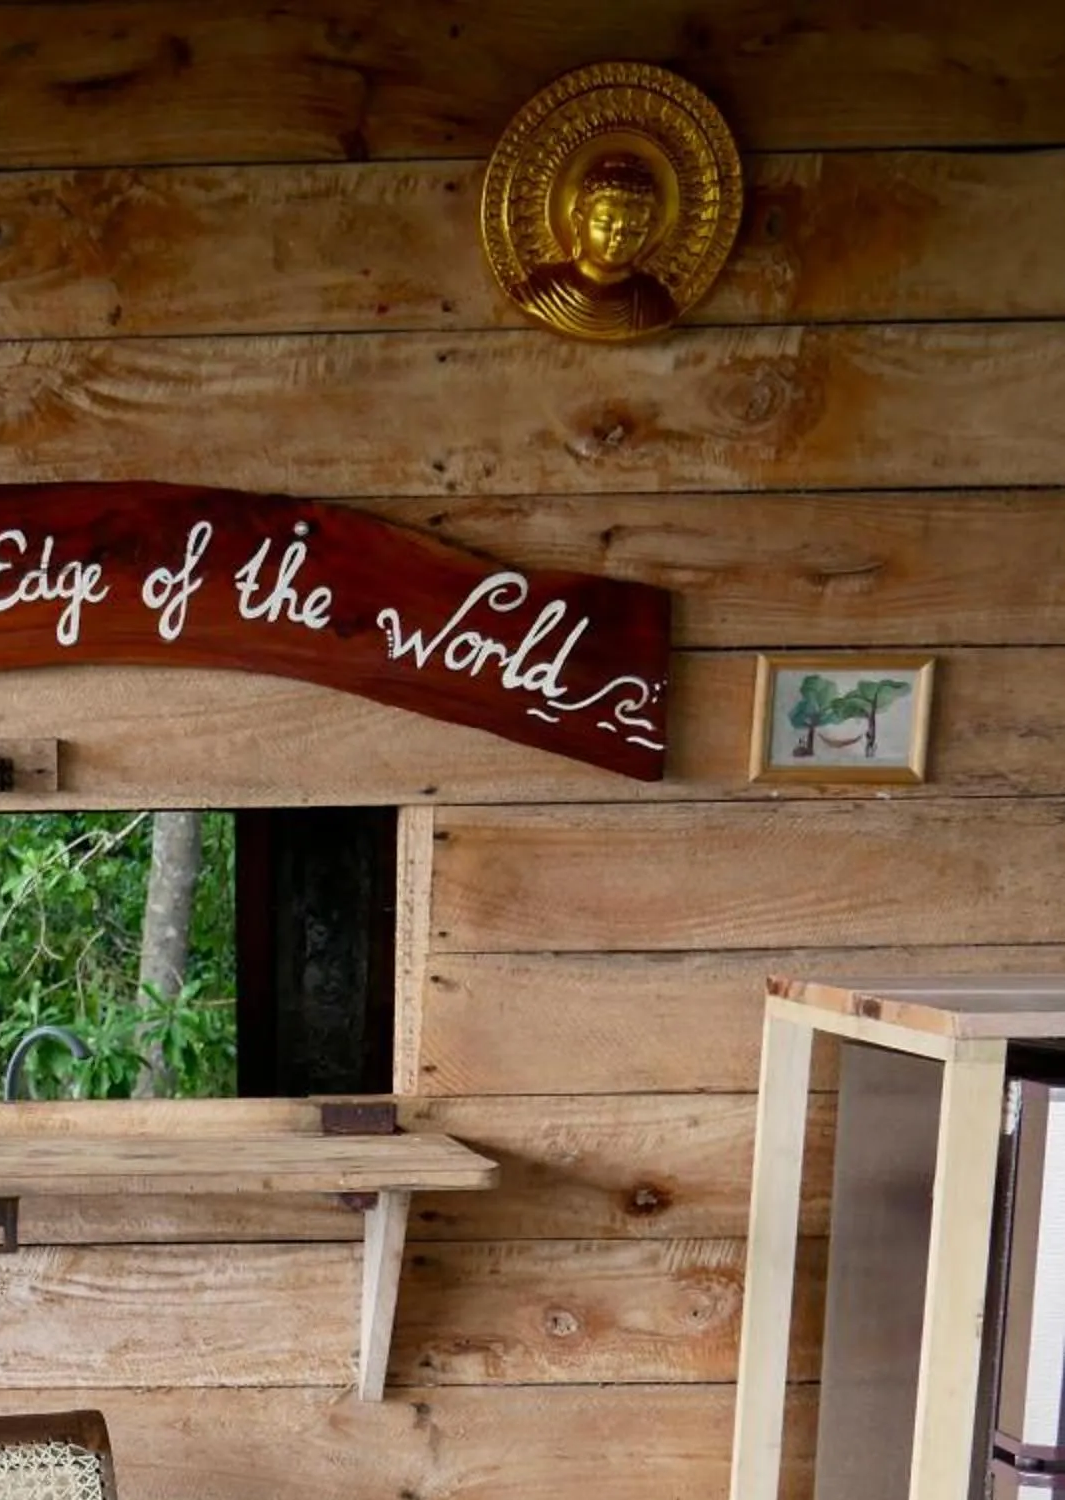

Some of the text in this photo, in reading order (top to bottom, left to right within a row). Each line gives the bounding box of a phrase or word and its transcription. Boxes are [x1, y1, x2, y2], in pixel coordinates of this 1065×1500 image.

[142, 520, 213, 642] of
[234, 537, 333, 629] the
[376, 571, 590, 697] World
